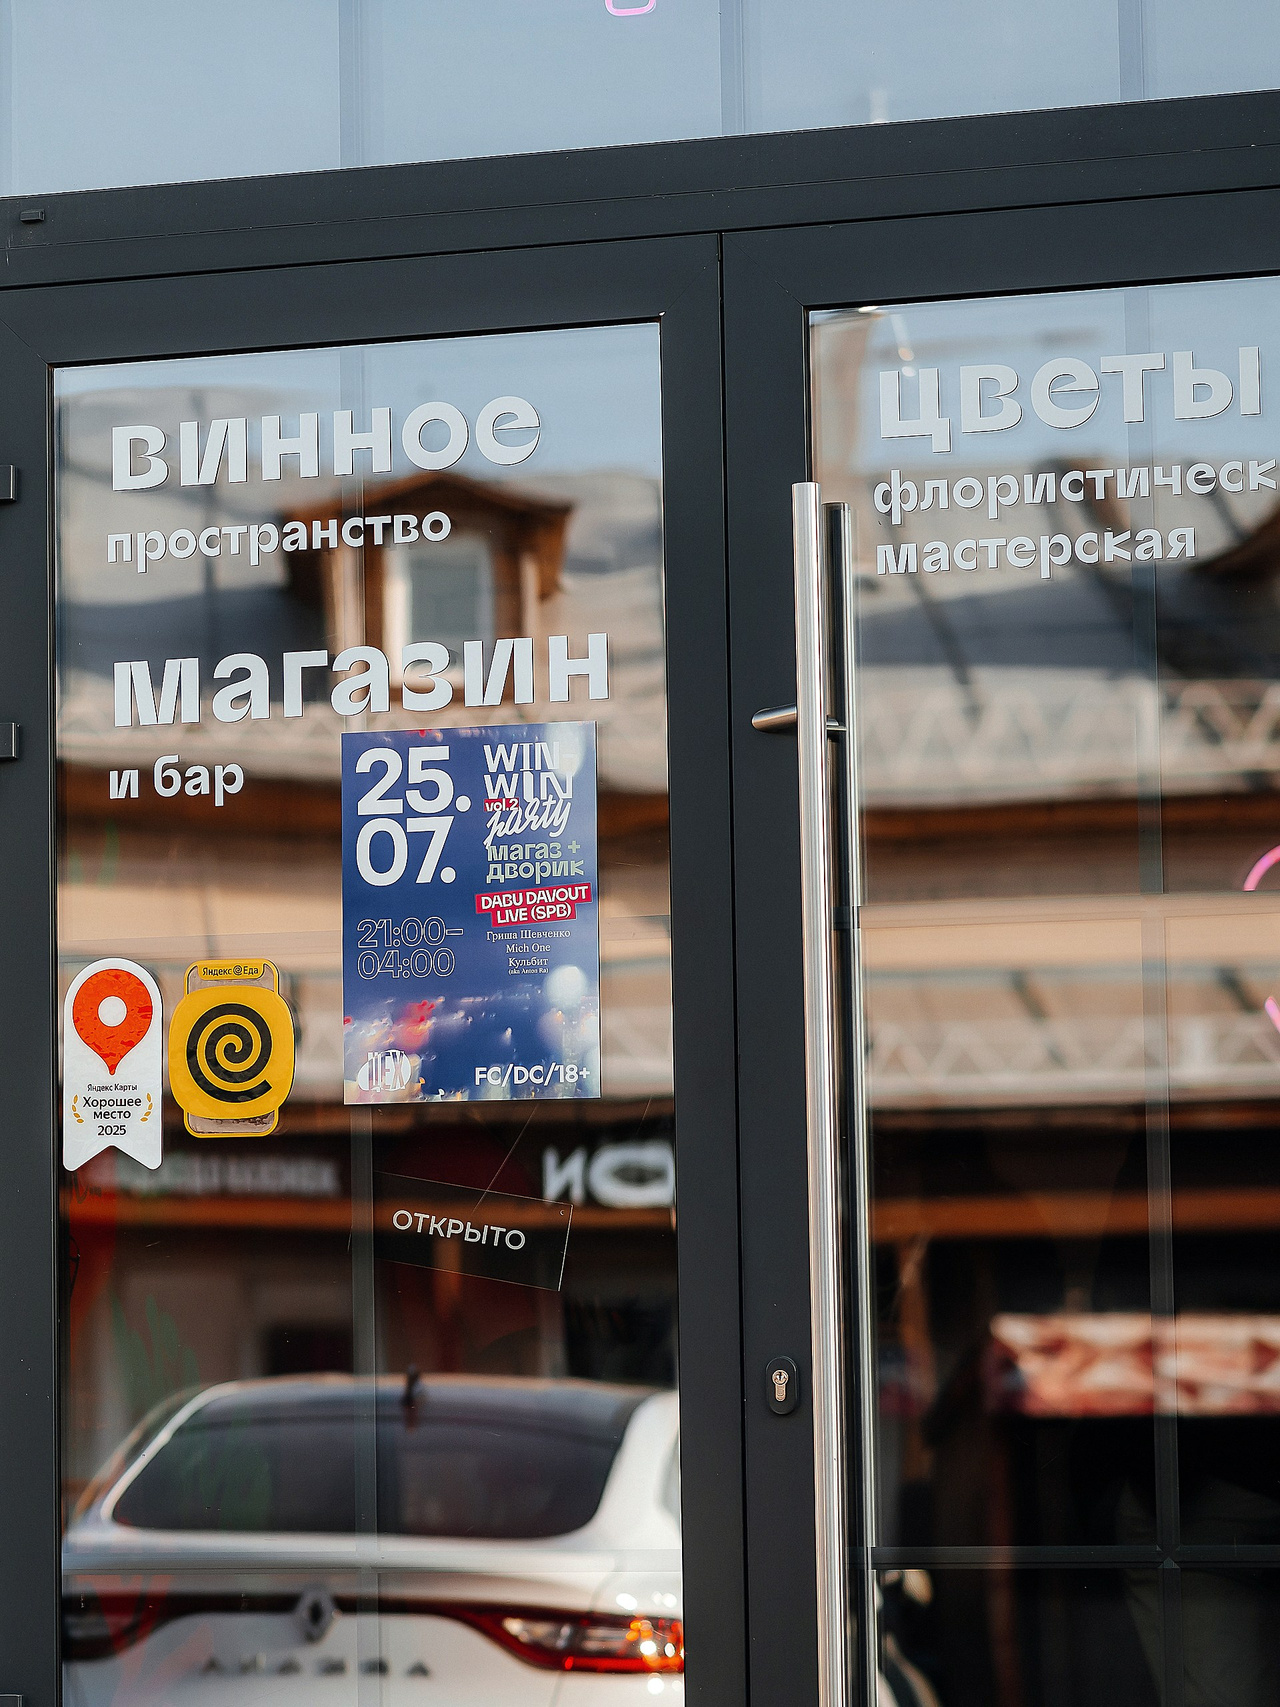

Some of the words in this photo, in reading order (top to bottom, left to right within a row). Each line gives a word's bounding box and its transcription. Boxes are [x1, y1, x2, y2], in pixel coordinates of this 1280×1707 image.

[879, 346, 1261, 454] цветы
[112, 396, 541, 492] винное
[873, 458, 1278, 526] флористическ
[107, 510, 452, 573] пространство
[876, 526, 1197, 580] мастерская
[113, 632, 610, 728] магазин
[109, 768, 140, 800] и
[153, 754, 245, 807] бар
[355, 745, 472, 816] 25.
[483, 771, 573, 803] WIN
[485, 798, 519, 812] vol.2
[483, 794, 571, 850] party
[355, 816, 458, 887] 07.
[487, 842, 562, 862] магаз
[486, 859, 584, 885] дворик
[481, 892, 523, 910] DABU
[525, 885, 589, 904] DAVOUT
[496, 908, 528, 924] LIVE
[531, 902, 572, 921] (SPB)
[486, 931, 518, 943] Гриша
[520, 929, 571, 939] Шевченко
[506, 943, 529, 954] Mich
[531, 943, 551, 952] One
[202, 967, 232, 977] Яндекс
[243, 966, 259, 975] Еда
[357, 947, 455, 980] 04:00
[508, 956, 549, 969] Кульбит
[367, 1050, 406, 1092] ЦЕХ
[474, 1061, 590, 1088] FC/DC/18+
[87, 1083, 113, 1092] Яндекс
[114, 1083, 138, 1092] Карты
[83, 1096, 142, 1110] Хорошее
[93, 1110, 131, 1120] место
[97, 1125, 127, 1136] 2025
[392, 1209, 526, 1250] ОТКРЫТО
